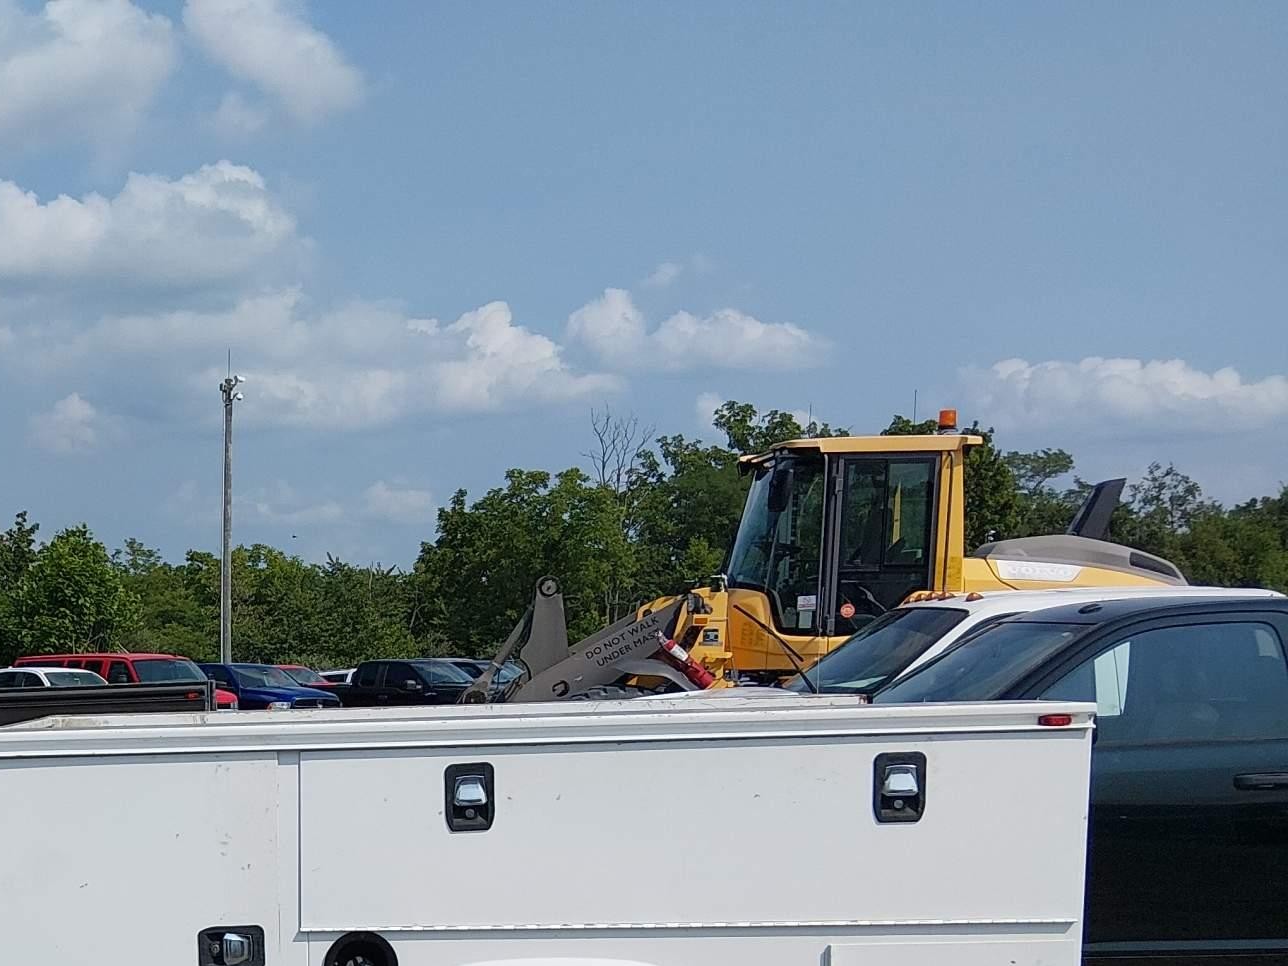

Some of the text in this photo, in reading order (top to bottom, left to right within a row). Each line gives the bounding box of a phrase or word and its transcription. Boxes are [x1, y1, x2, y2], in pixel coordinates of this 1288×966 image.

[585, 616, 659, 660] DO NOT WALK
[596, 644, 633, 667] UNDER
